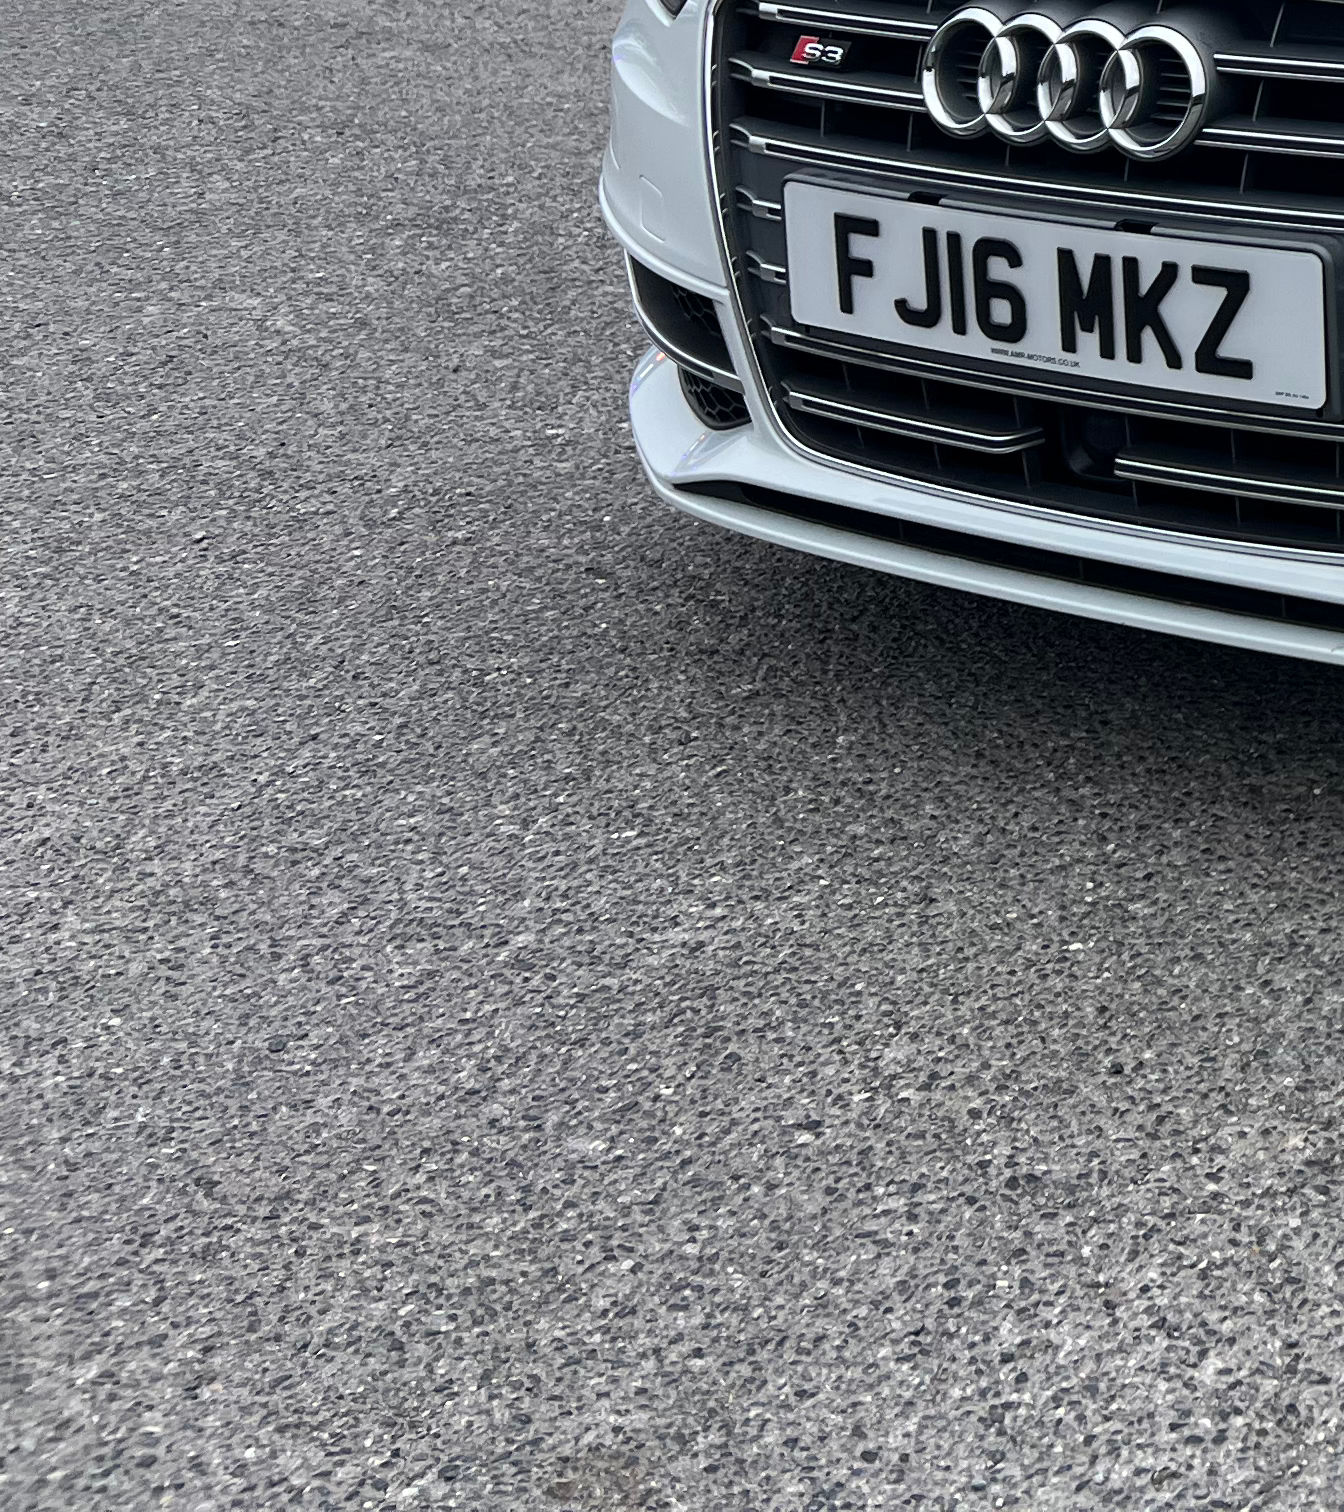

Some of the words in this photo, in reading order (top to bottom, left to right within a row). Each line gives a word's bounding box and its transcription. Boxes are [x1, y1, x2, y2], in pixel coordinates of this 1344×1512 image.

[801, 42, 844, 65] S3
[832, 209, 1027, 344] FJ16
[1056, 246, 1254, 381] MKZ
